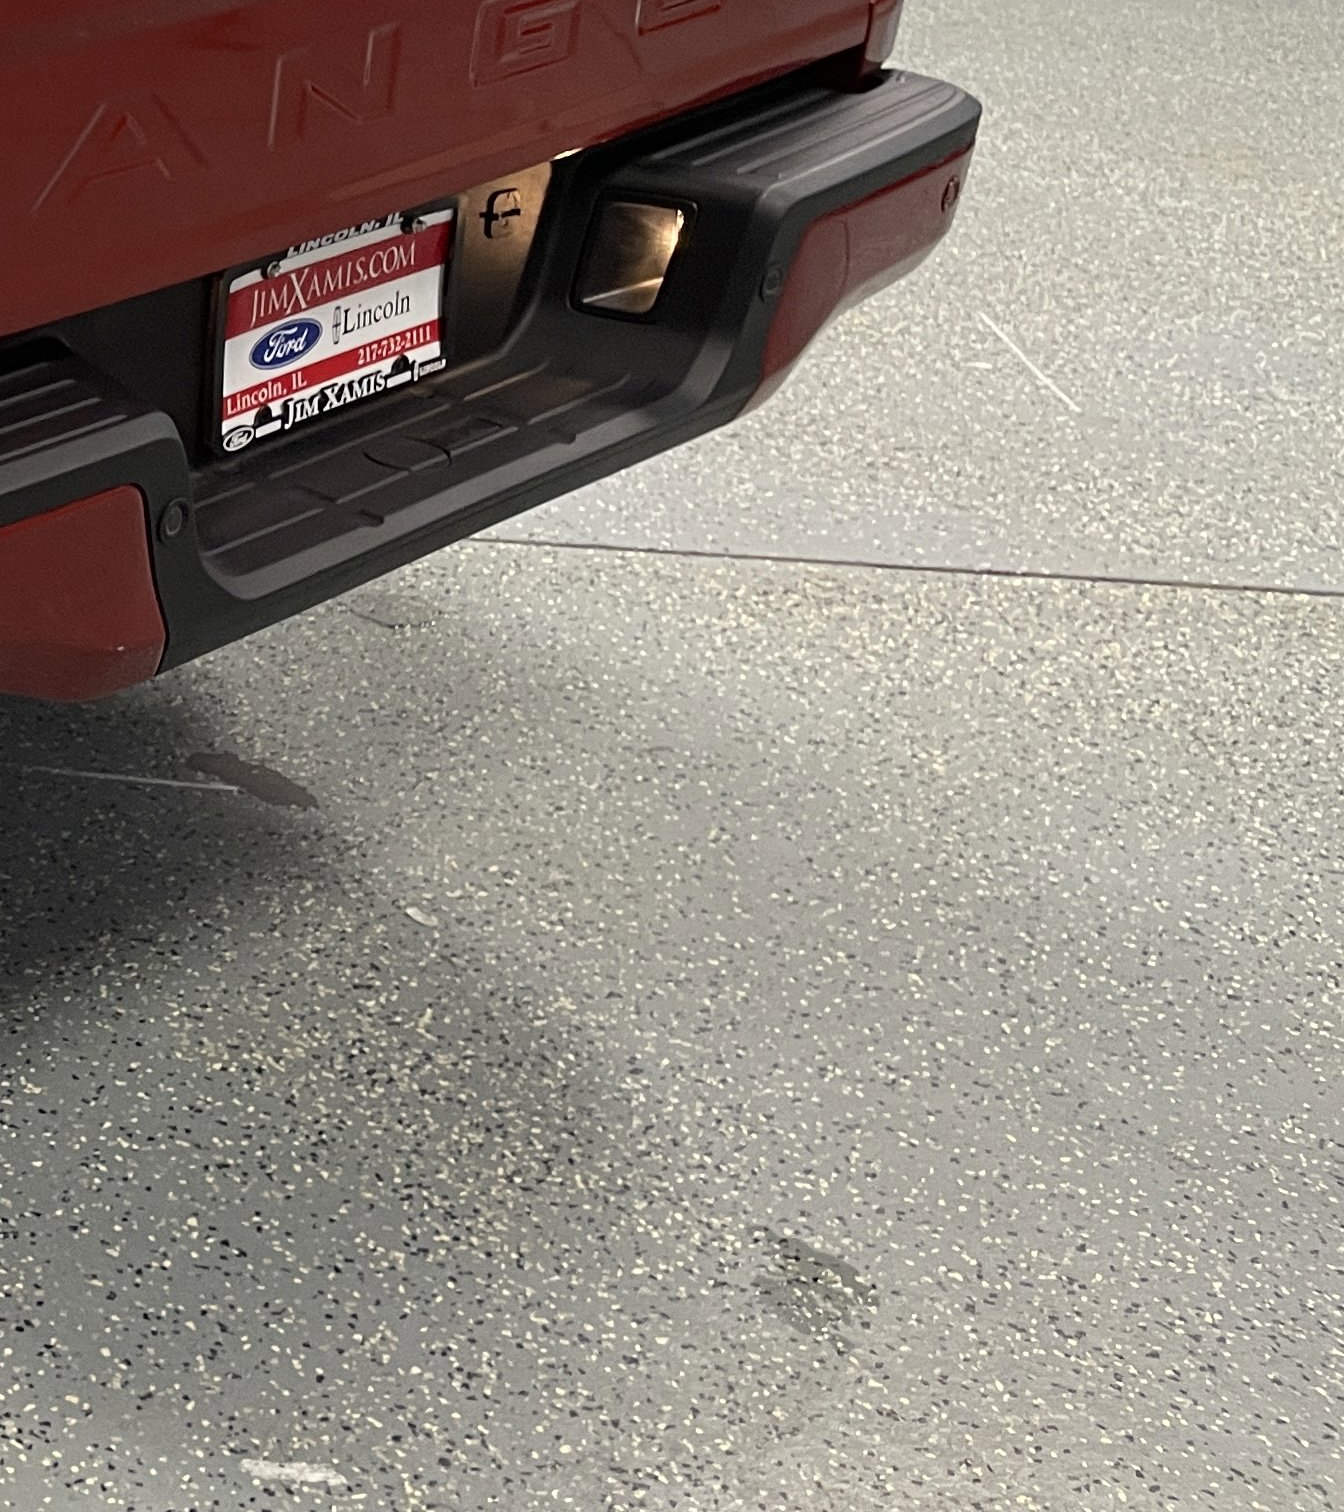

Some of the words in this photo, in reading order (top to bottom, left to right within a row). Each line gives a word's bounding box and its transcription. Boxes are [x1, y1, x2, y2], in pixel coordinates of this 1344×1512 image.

[342, 290, 410, 335] Lincoln
[263, 326, 308, 364] Ford
[357, 325, 431, 366] 217-732-2111
[226, 380, 288, 416] Lincoln,
[292, 371, 308, 390] IL
[284, 394, 320, 430] JIM
[323, 374, 388, 412] XAMIS
